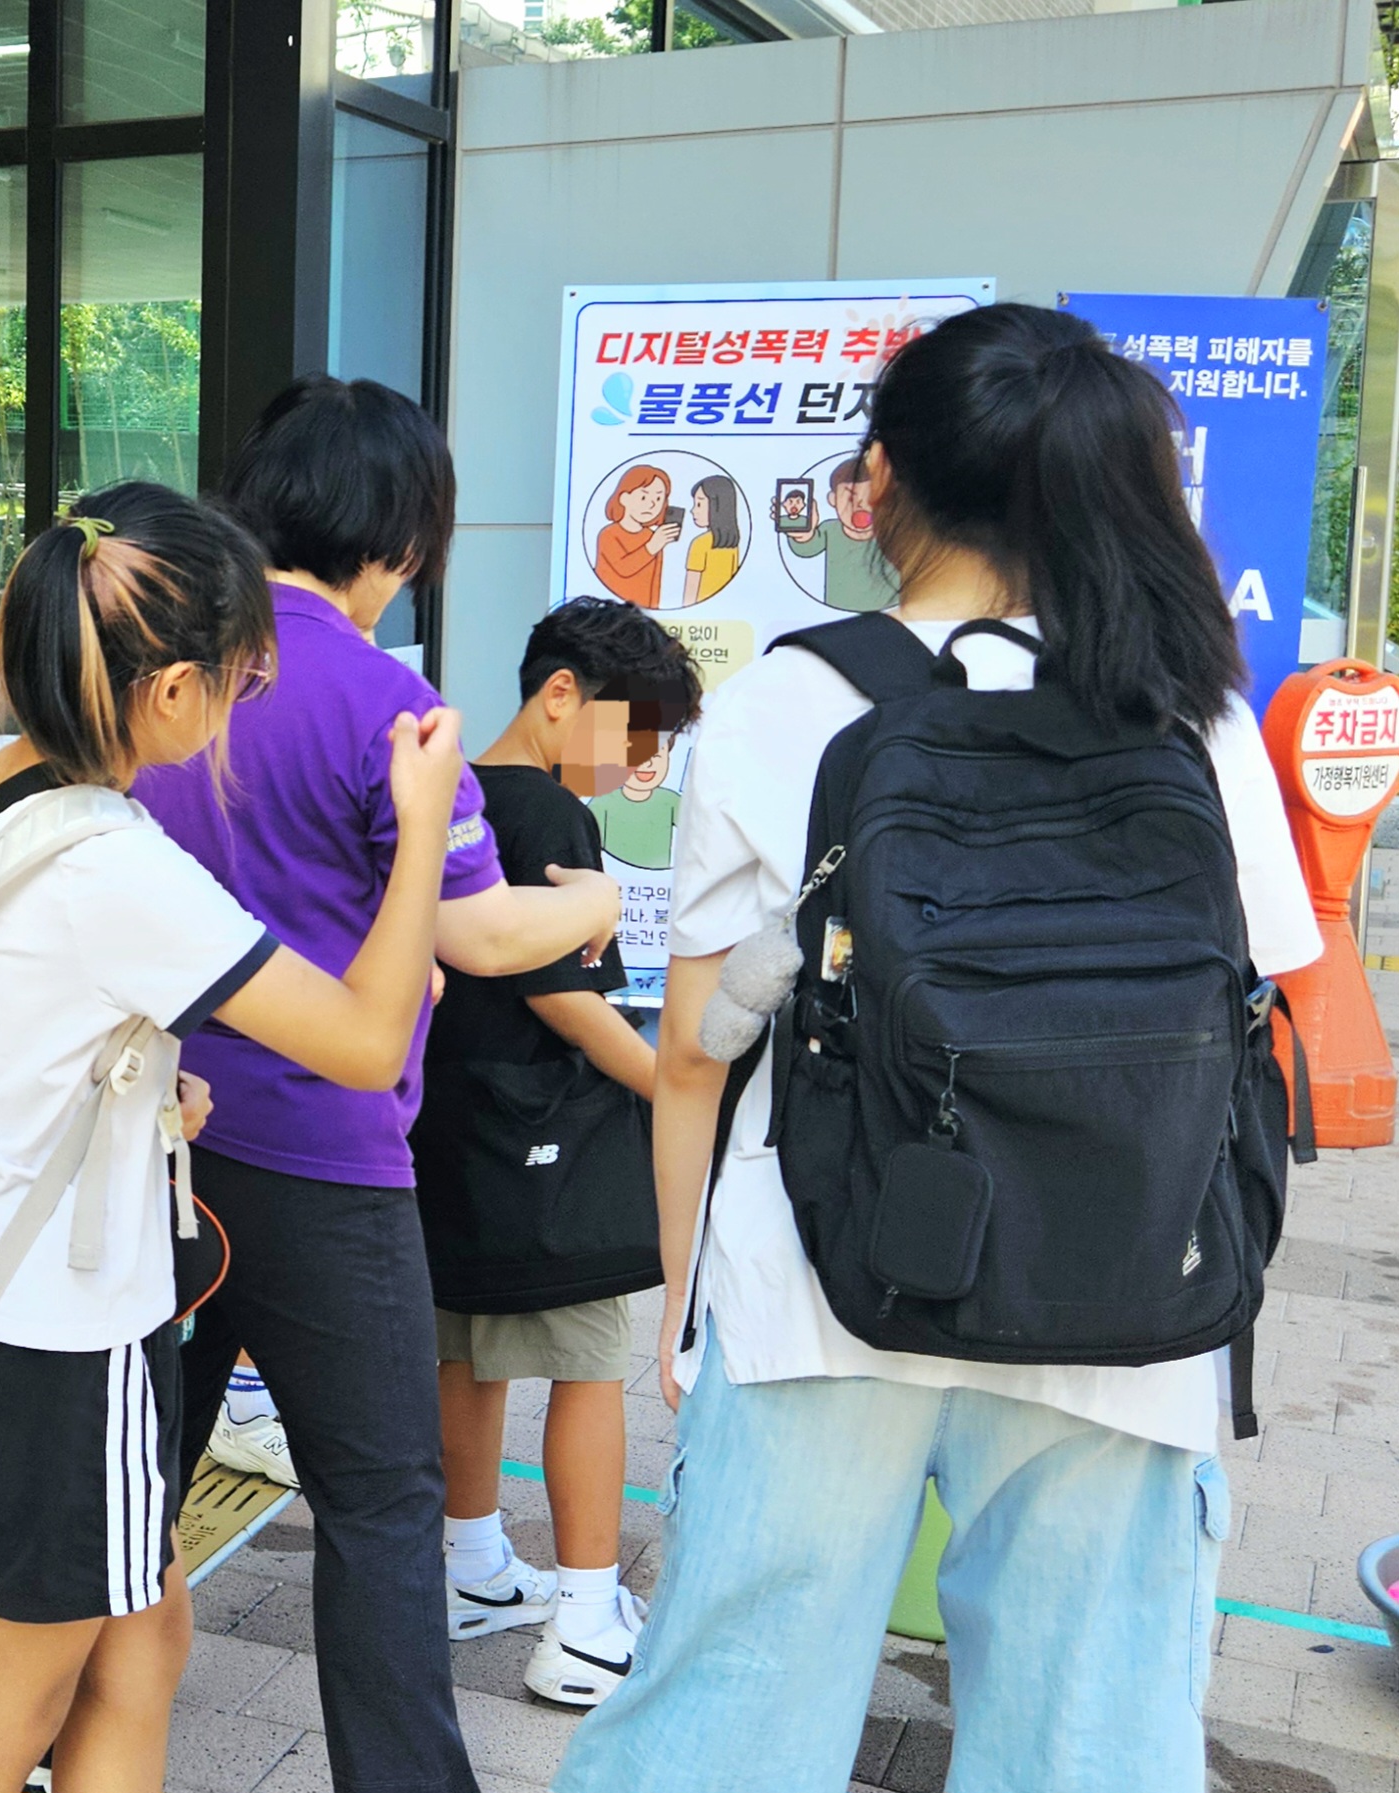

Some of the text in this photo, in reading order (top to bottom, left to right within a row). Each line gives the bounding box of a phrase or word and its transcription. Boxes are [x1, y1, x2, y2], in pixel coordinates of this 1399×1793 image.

[595, 328, 829, 366] 디지털성폭력
[1122, 334, 1198, 363] 성폭력
[1206, 337, 1313, 366] 피해자를
[1168, 369, 1307, 399] 지원합니다.
[637, 382, 782, 425] 물풍선
[688, 626, 719, 642] 없이
[1314, 708, 1398, 746] 주차금지
[1313, 764, 1389, 791] 가정행복지원센터
[627, 886, 671, 902] 친구의
